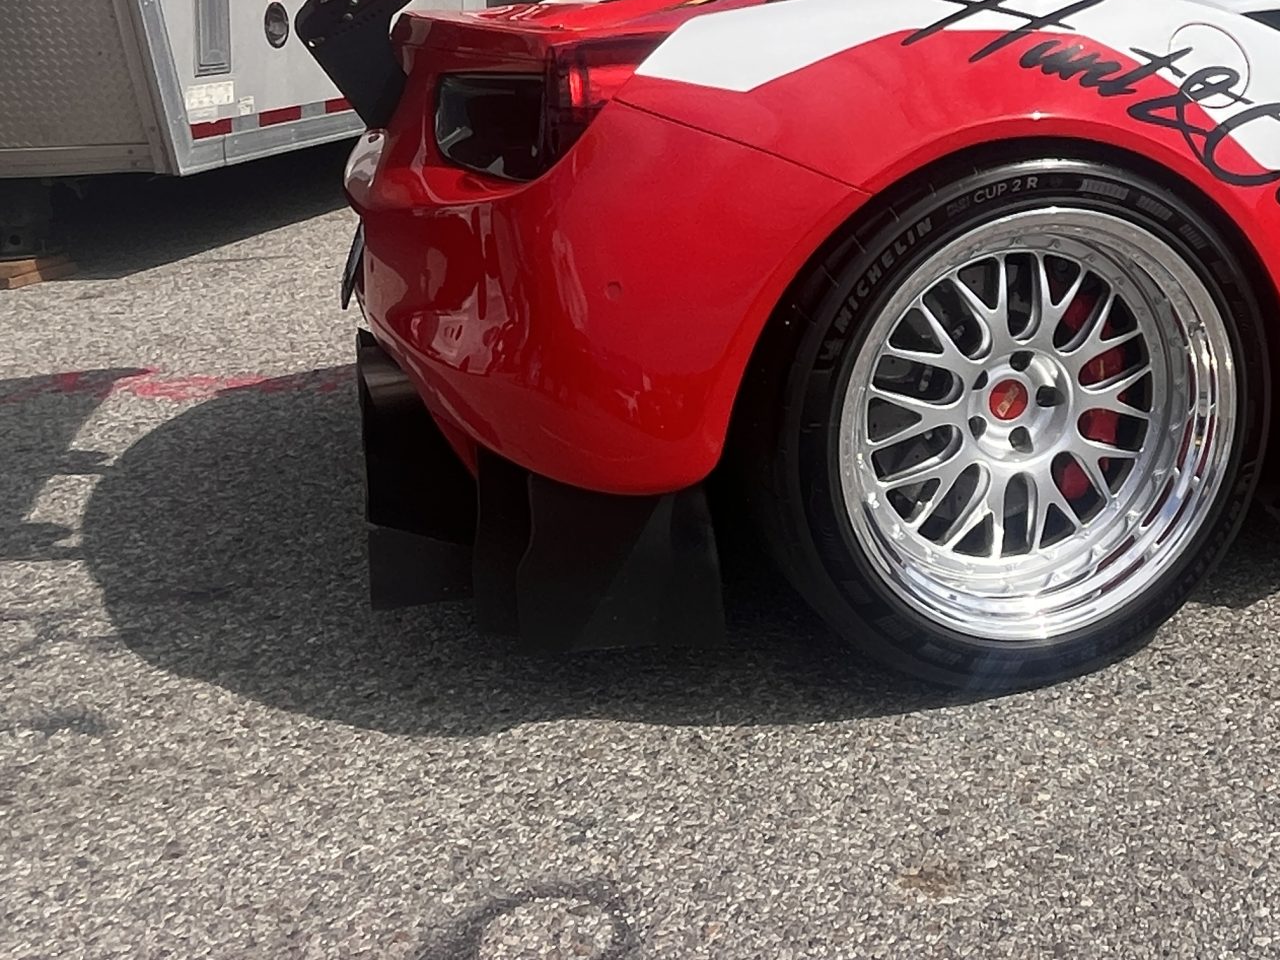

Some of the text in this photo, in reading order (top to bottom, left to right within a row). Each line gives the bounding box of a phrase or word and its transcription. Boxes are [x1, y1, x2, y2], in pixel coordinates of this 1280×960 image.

[974, 176, 1039, 203] CUP 2 R
[833, 217, 932, 334] MICHELIN
